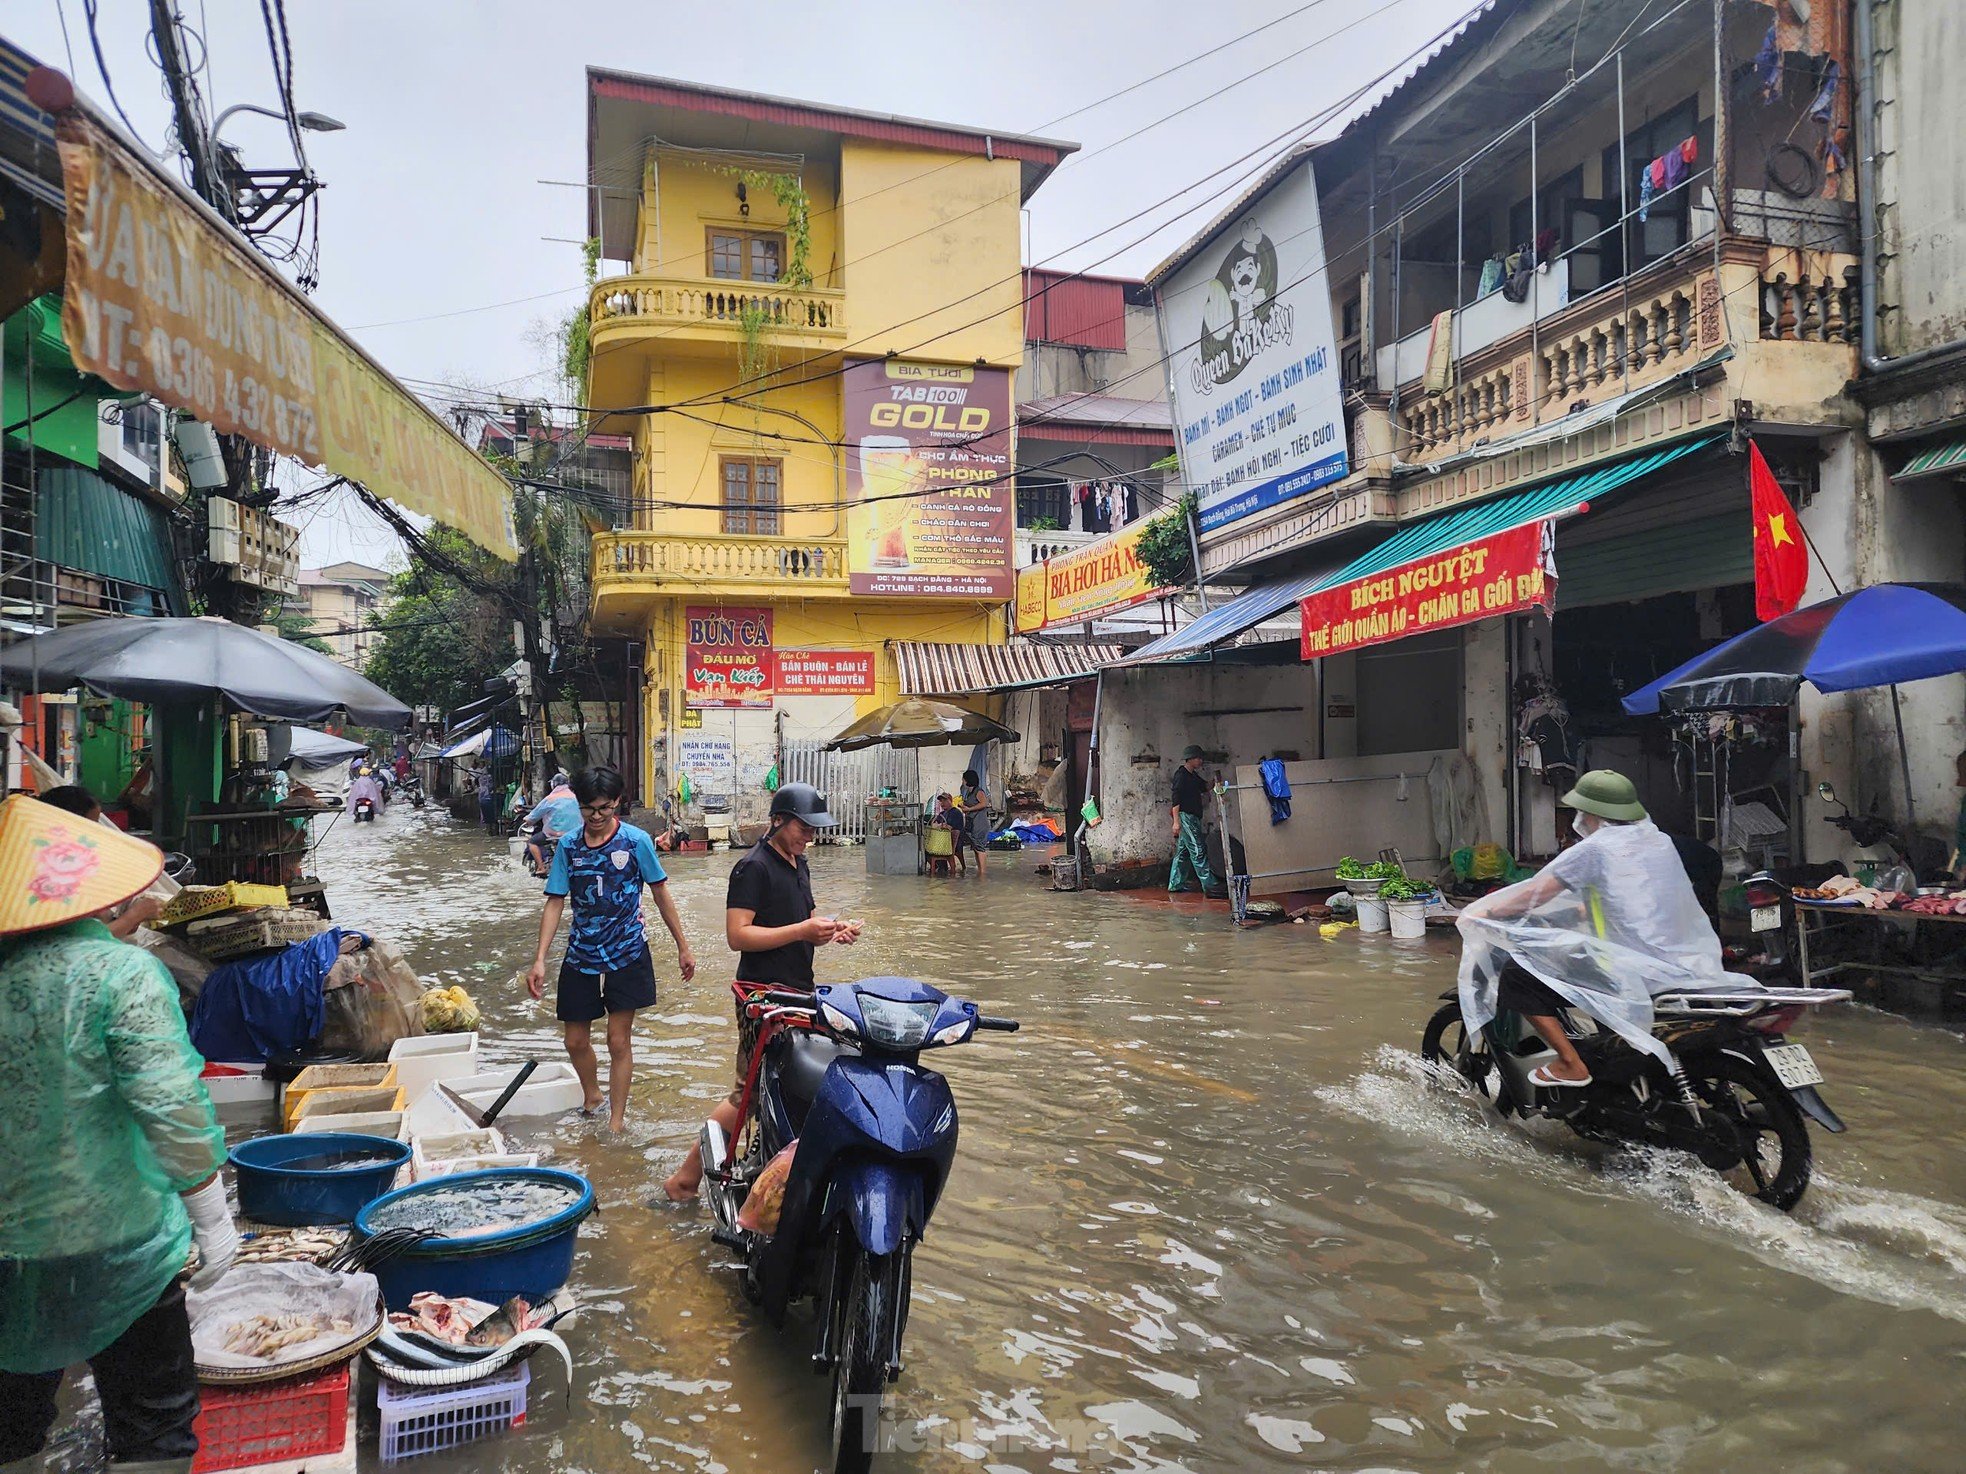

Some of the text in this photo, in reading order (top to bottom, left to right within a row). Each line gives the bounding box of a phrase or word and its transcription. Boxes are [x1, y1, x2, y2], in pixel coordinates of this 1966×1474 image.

[898, 365, 922, 376] BIA
[1190, 349, 1230, 395] Queen
[1260, 373, 1282, 402] BÁNH
[1283, 360, 1304, 389] SINH
[1305, 346, 1328, 378] NHẬT
[869, 402, 991, 432] GOLD
[1261, 447, 1282, 467] NGHỊ
[1290, 433, 1310, 458] TIỆC
[1313, 421, 1336, 448] CƯỚI
[919, 451, 945, 462] CHỢ
[928, 467, 997, 480] PHONG
[920, 503, 946, 511] CANH
[1050, 573, 1071, 599] BIA
[1101, 544, 1123, 581] HÀ
[1351, 547, 1488, 611] BÍCH NGUYỆT
[870, 584, 915, 592] HOTLINE
[1020, 601, 1042, 616] HABECO
[1309, 621, 1331, 651] THẾ
[1332, 619, 1353, 647] GIỚI
[1355, 608, 1389, 642] QUẦN
[1391, 605, 1407, 632] ÁO
[1418, 592, 1458, 625] CHĂN
[1462, 587, 1480, 614] GA
[1484, 570, 1513, 609] GỐI
[689, 612, 770, 647] BÚN CÁ
[781, 660, 801, 672] BÁN
[803, 661, 828, 672] BUÔN
[836, 661, 855, 672] BÁN
[693, 667, 766, 687] Vạn Kiếp
[785, 673, 865, 685] CHÈ THÁI NGUYÊN
[595, 875, 603, 897] 1
[886, 1065, 916, 1076] HONDA
